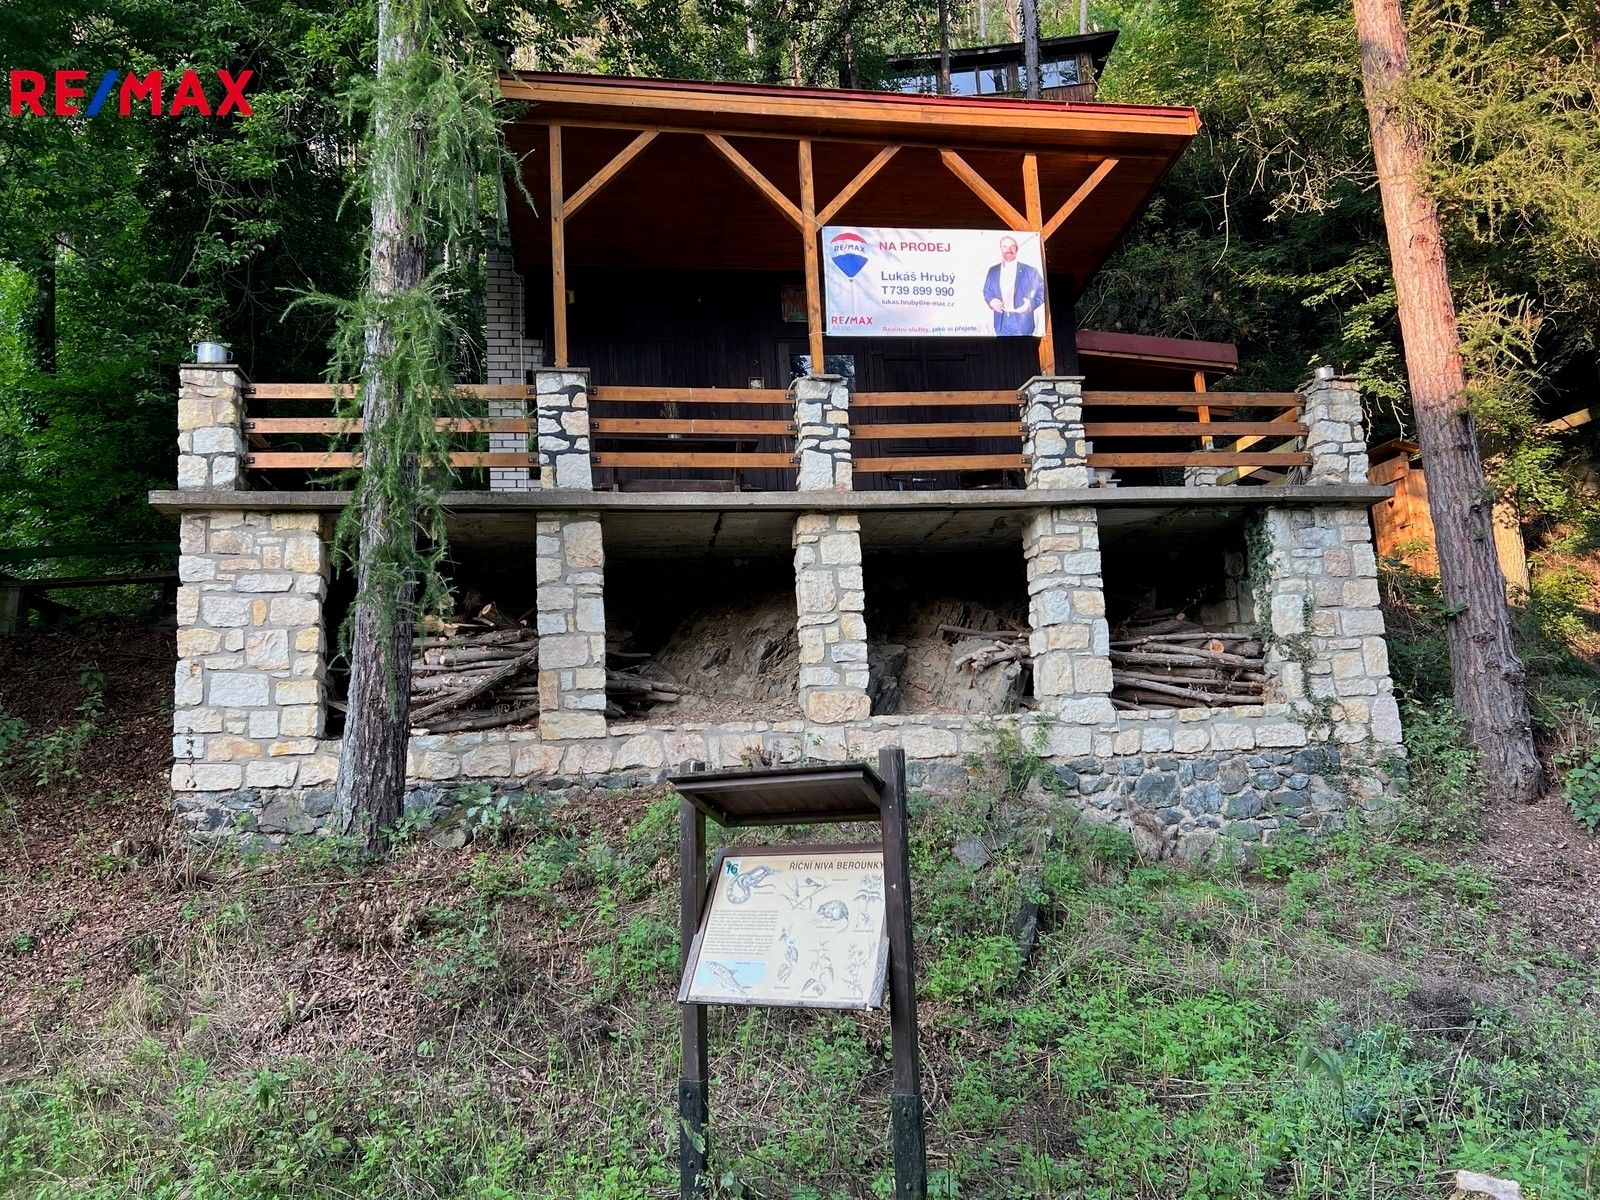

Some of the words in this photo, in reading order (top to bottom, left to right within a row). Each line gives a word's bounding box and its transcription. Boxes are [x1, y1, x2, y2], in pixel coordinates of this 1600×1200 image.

[833, 244, 866, 253] RE/MAX
[879, 241, 897, 251] NA
[900, 242, 951, 252] PRODEJ
[881, 271, 917, 281] Lukáš
[920, 272, 956, 285] Hrubý
[912, 286, 932, 296] 899
[935, 286, 955, 296] 990
[831, 316, 873, 325] RE/MAX
[814, 861, 834, 870] NIVA
